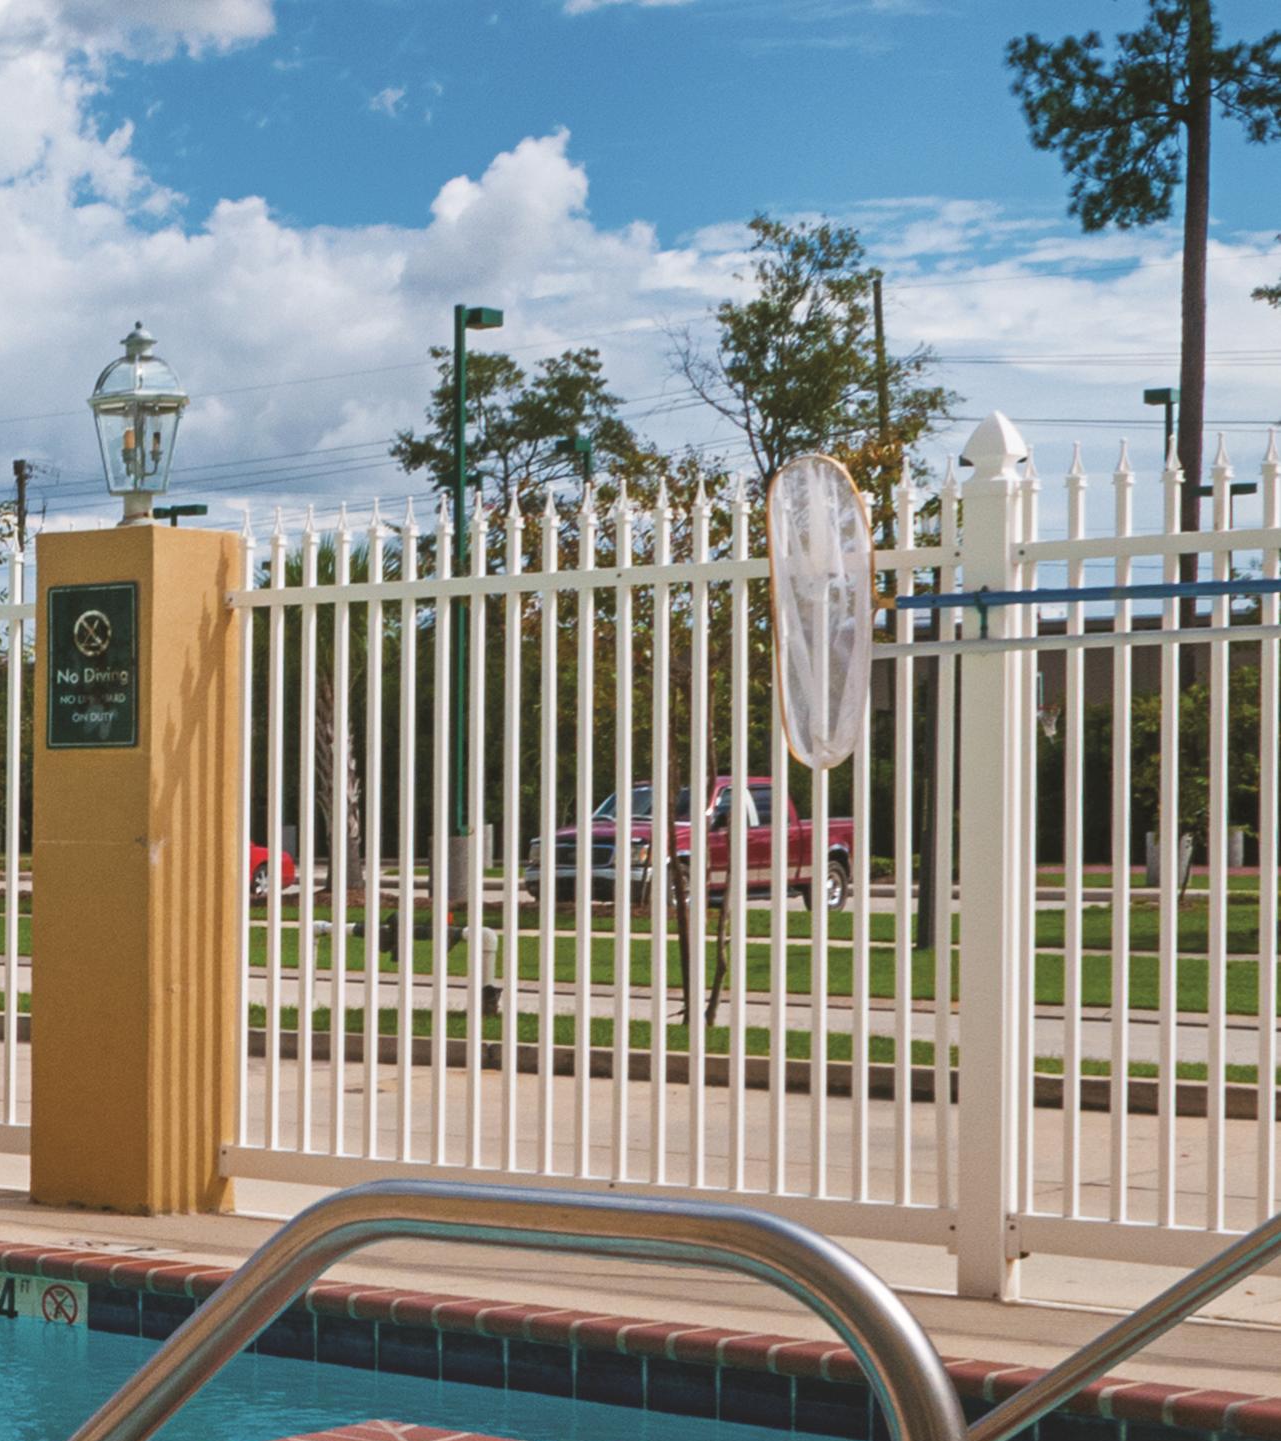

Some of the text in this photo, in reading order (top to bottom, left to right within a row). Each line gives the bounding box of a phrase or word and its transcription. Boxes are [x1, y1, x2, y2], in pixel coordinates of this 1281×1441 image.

[57, 666, 128, 685] No Diving
[59, 695, 76, 705] NO
[71, 711, 115, 722] ON DUTY
